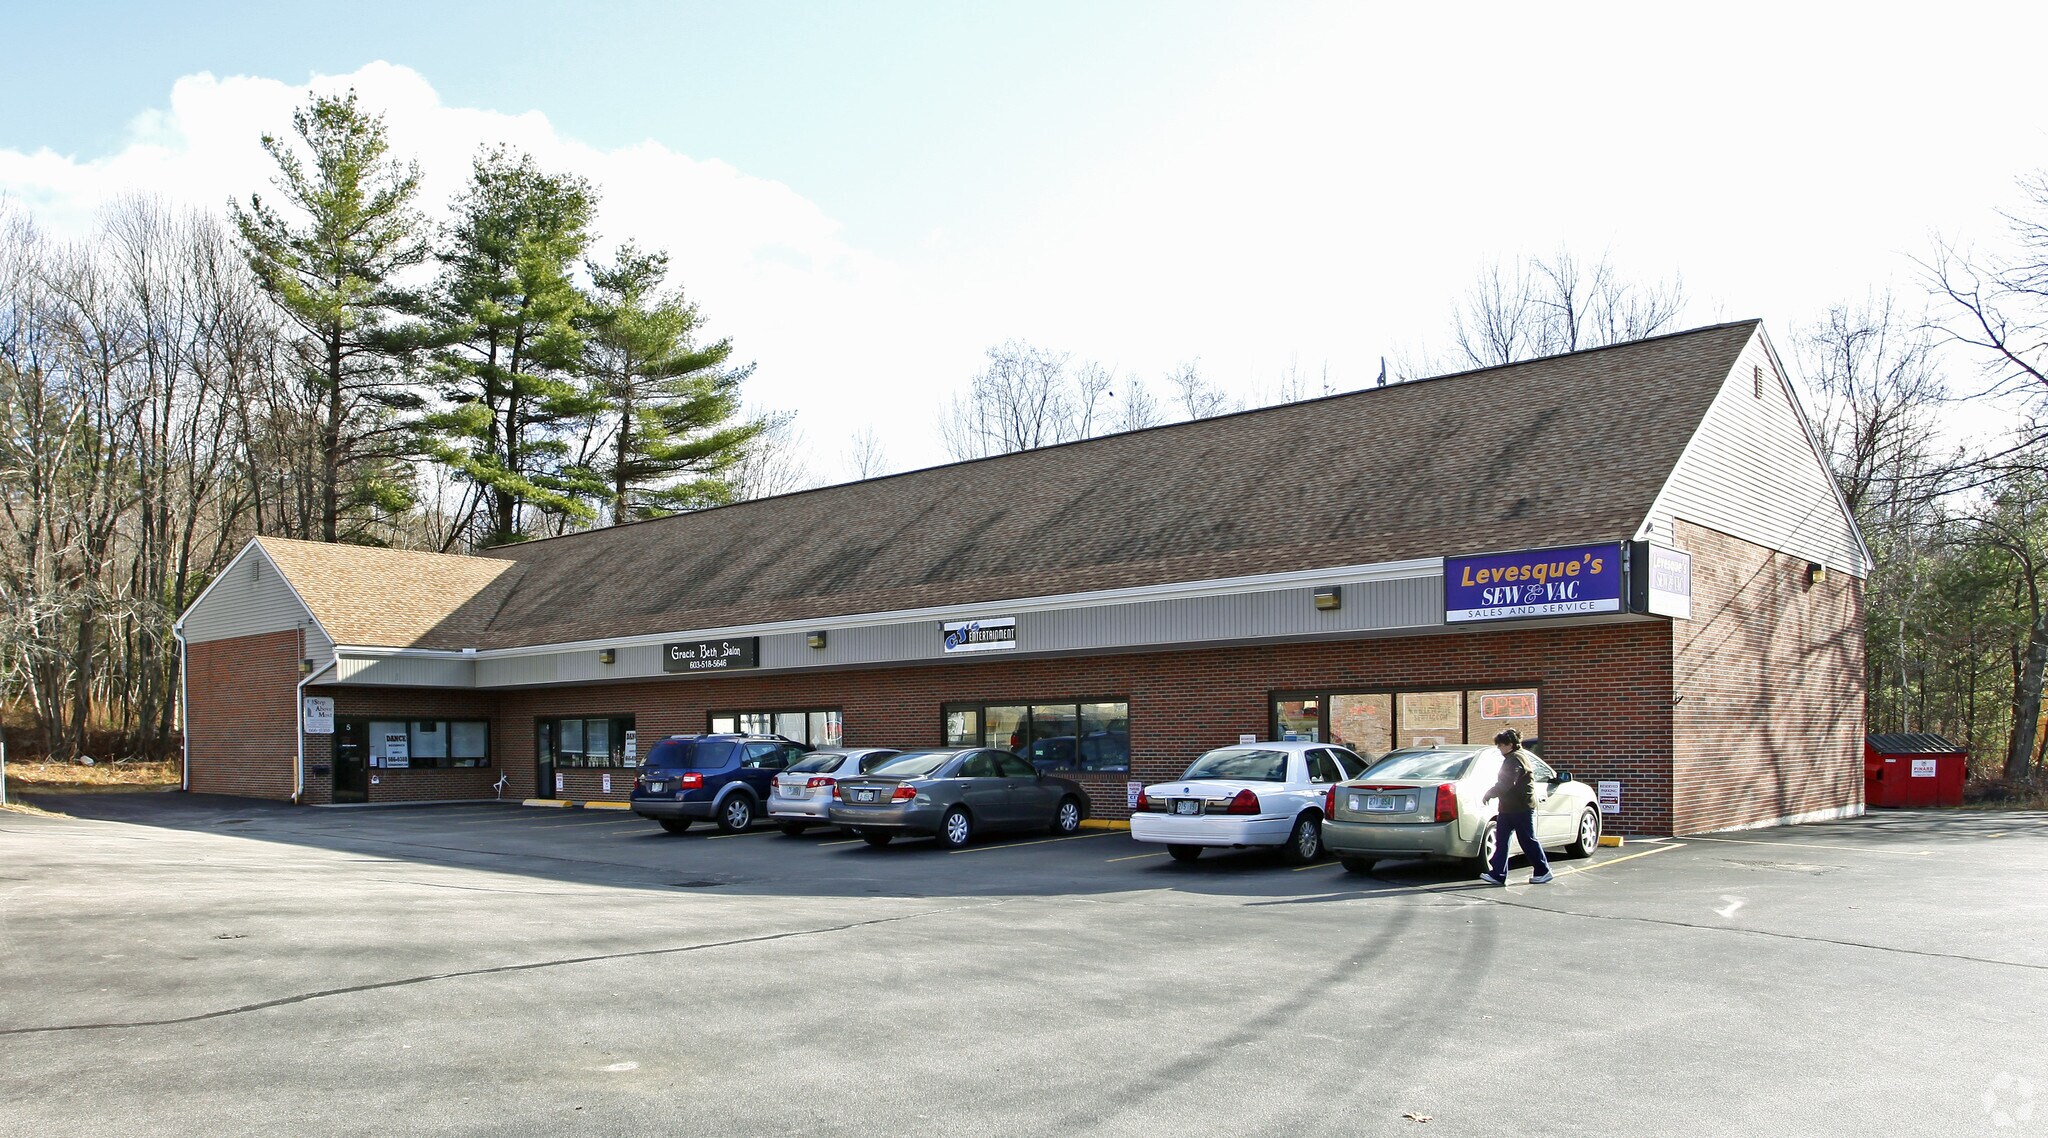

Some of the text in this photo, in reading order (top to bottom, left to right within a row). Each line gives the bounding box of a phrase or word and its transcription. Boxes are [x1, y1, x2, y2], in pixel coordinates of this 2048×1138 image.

[1461, 553, 1603, 586] Levesque's
[1481, 581, 1580, 606] SEW & VAC
[1468, 602, 1595, 618] SALES AND SERVICE
[944, 621, 980, 650] CJ's
[969, 629, 1015, 642] ENTERTAINMENT
[671, 642, 741, 660] Gracie Beth Salon
[1483, 696, 1535, 717] OPEN
